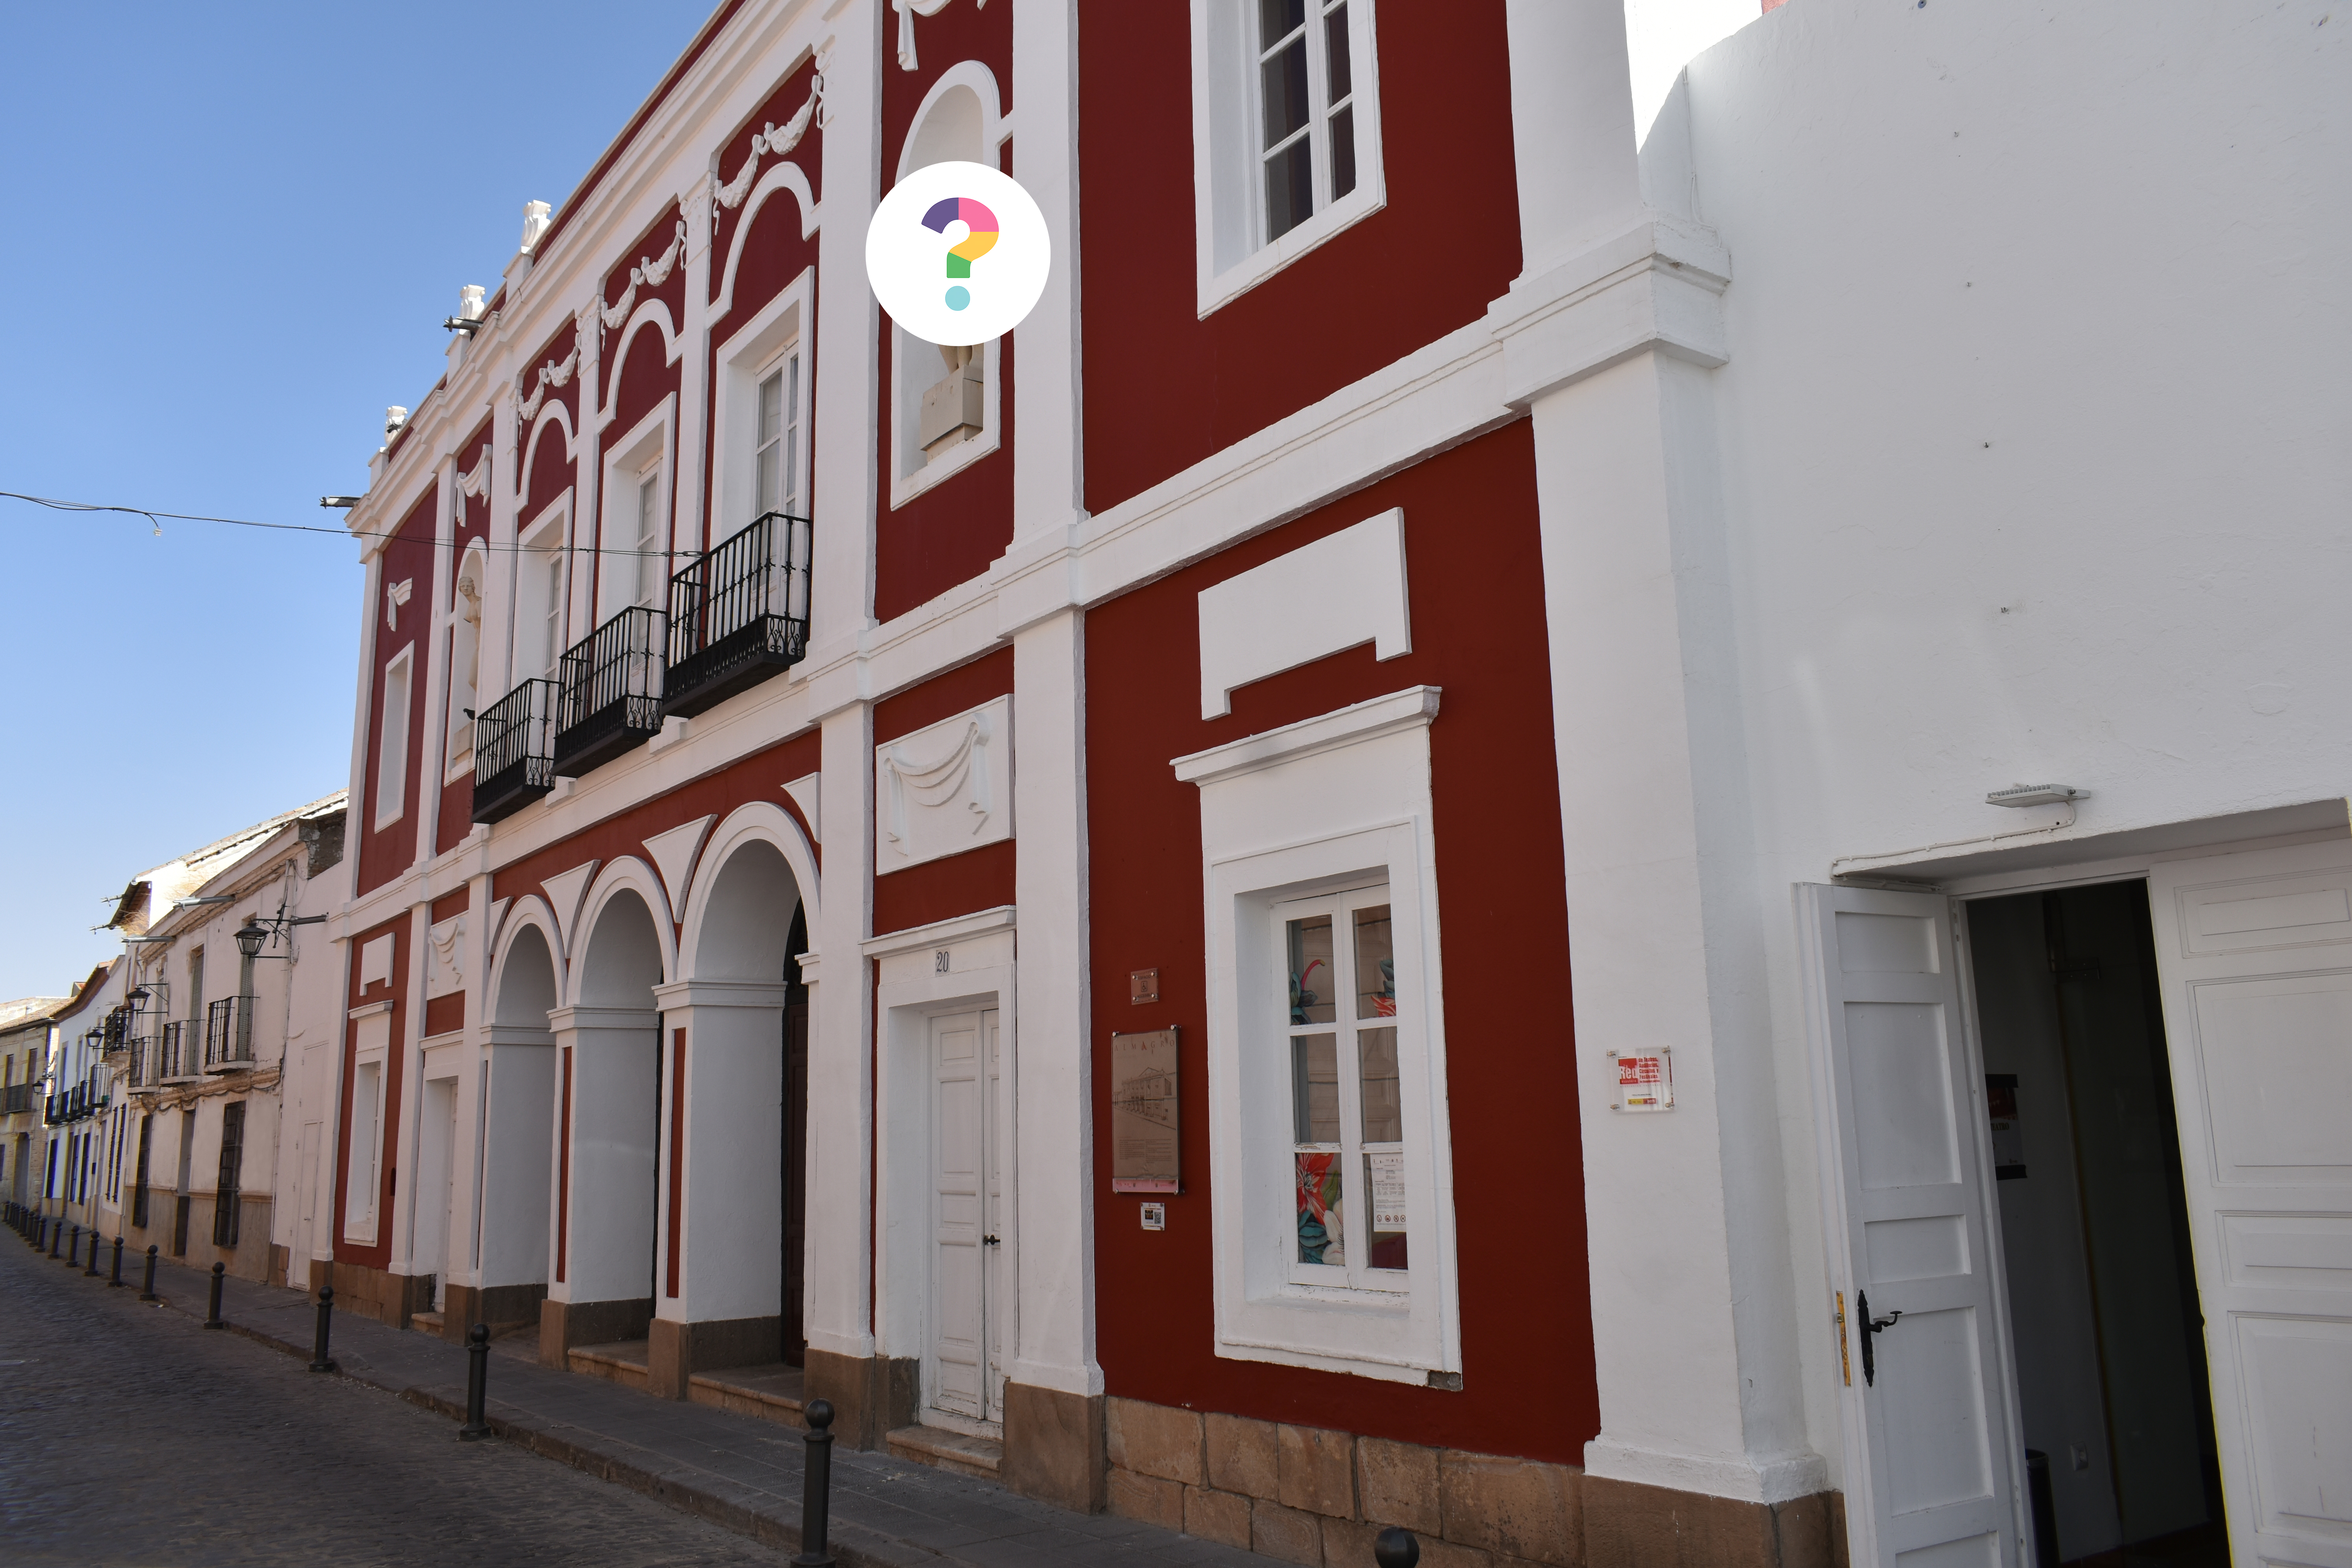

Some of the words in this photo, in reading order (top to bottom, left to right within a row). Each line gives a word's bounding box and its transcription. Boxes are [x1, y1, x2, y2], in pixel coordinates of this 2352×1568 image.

[936, 951, 949, 973] 20
[1114, 1040, 1174, 1051] ALMAGRO
[1619, 1065, 1637, 1079] Red
